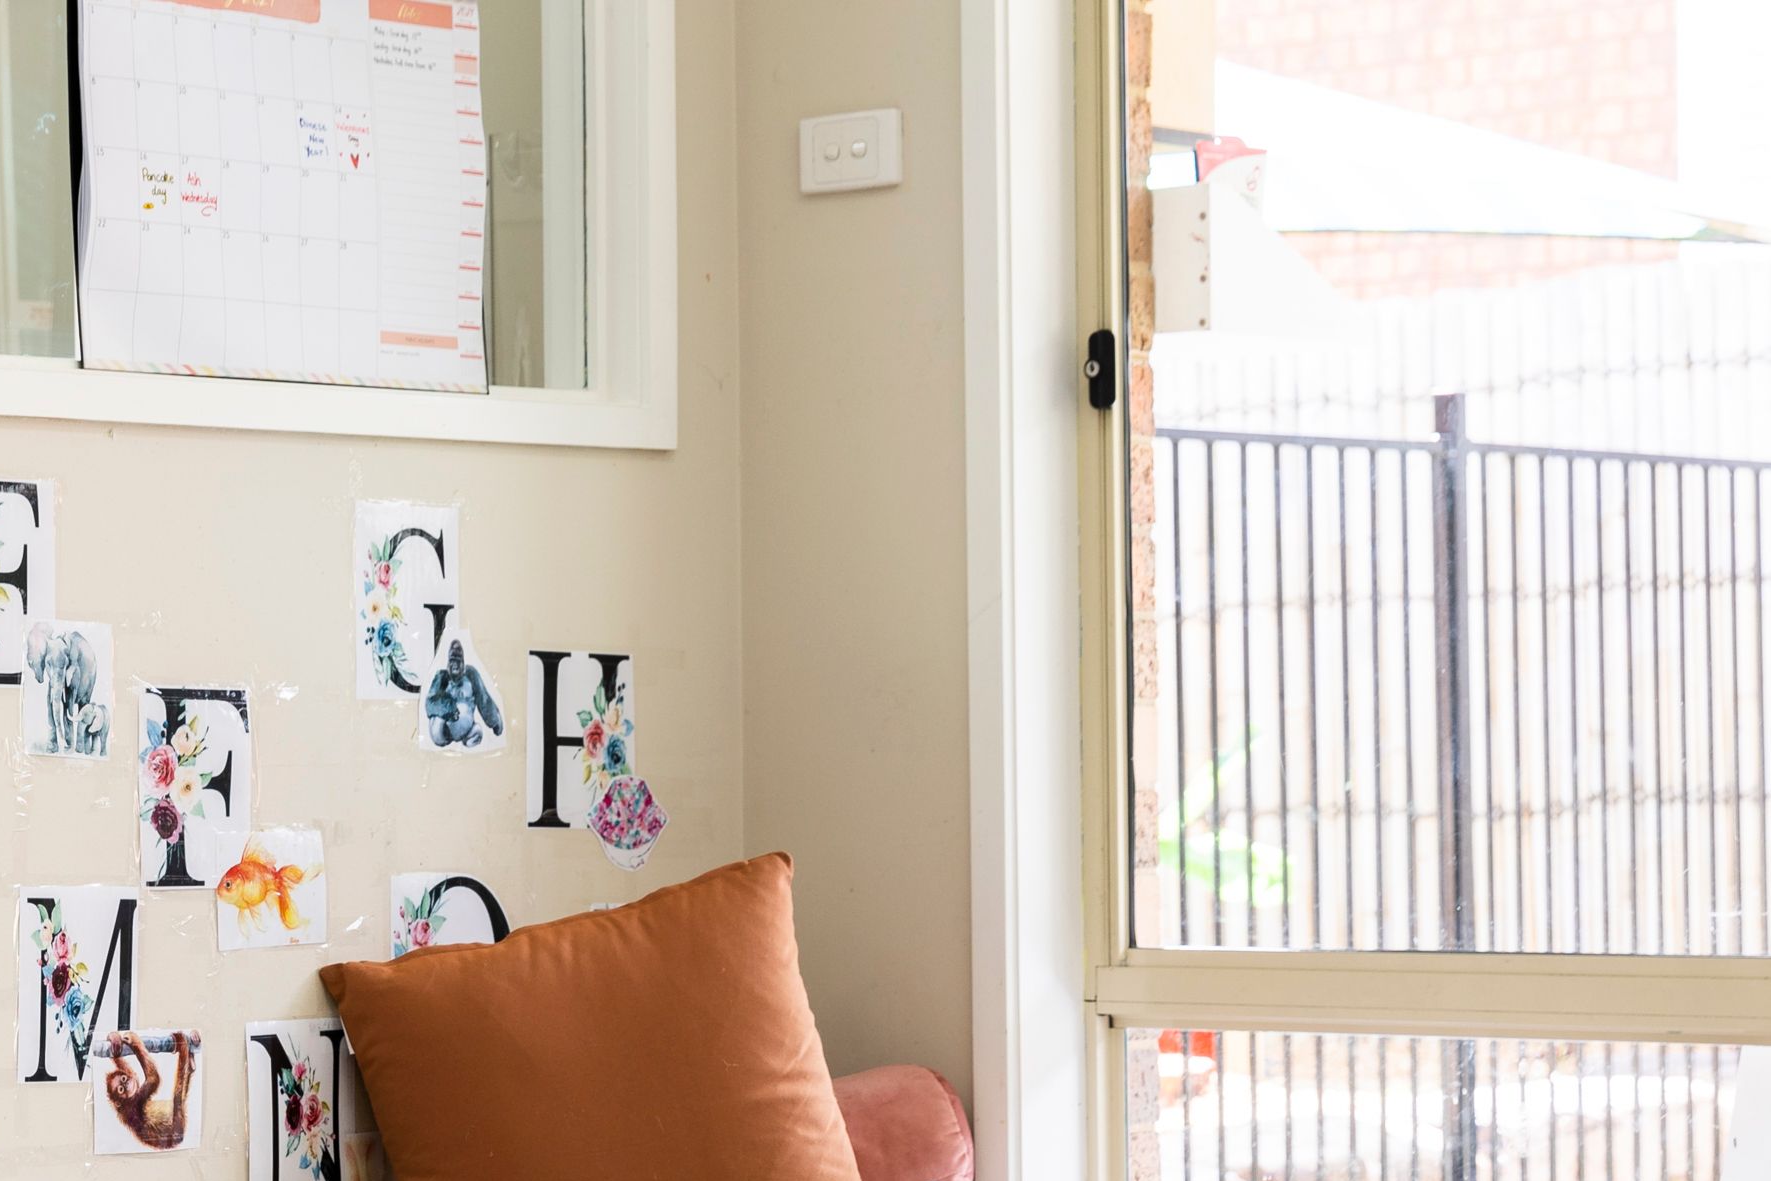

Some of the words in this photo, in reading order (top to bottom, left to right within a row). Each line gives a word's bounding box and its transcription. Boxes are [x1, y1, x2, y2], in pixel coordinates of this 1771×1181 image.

[142, 167, 174, 184] Pancake
[151, 185, 167, 205] day
[363, 527, 455, 694] G
[146, 687, 250, 888] F
[528, 651, 631, 829] H
[26, 896, 138, 1082] M
